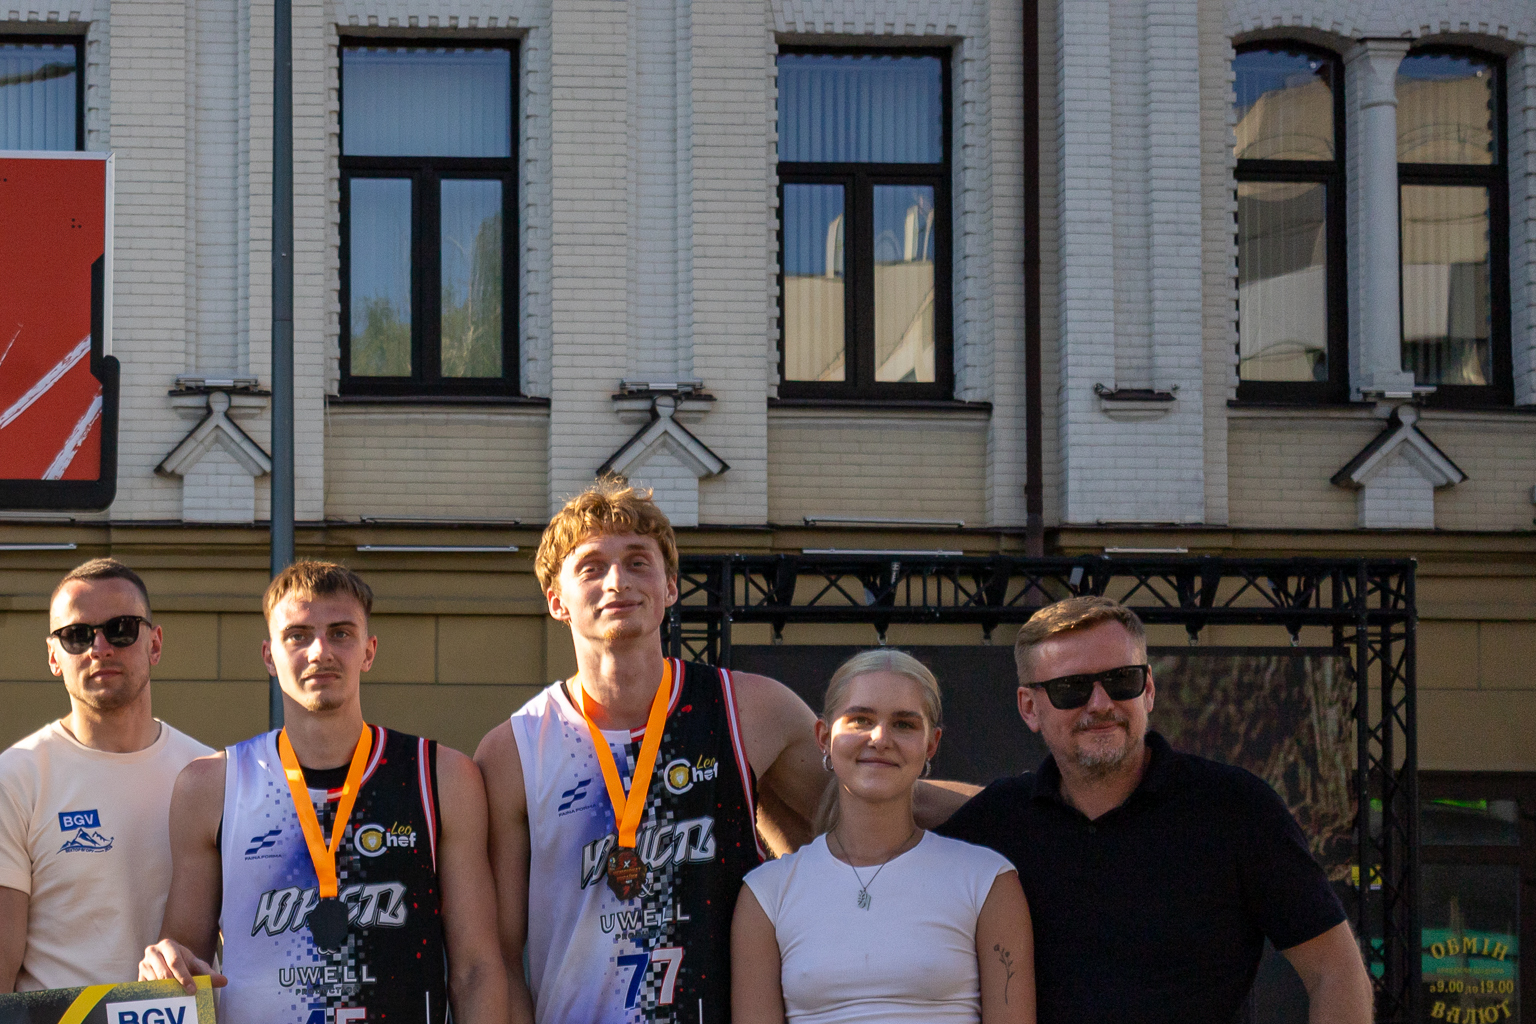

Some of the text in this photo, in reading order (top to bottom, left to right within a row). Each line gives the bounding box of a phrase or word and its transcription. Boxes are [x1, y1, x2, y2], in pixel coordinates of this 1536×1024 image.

[63, 814, 94, 827] BGV
[392, 822, 412, 836] Leo
[600, 904, 691, 934] UWELL
[1430, 936, 1508, 962] ОБМІН
[279, 964, 377, 987] UWELL
[617, 946, 683, 1010] 77
[1437, 980, 1464, 993] 9.00
[1480, 980, 1514, 994] 19.00
[1431, 998, 1512, 1024] ВАЛЮТ
